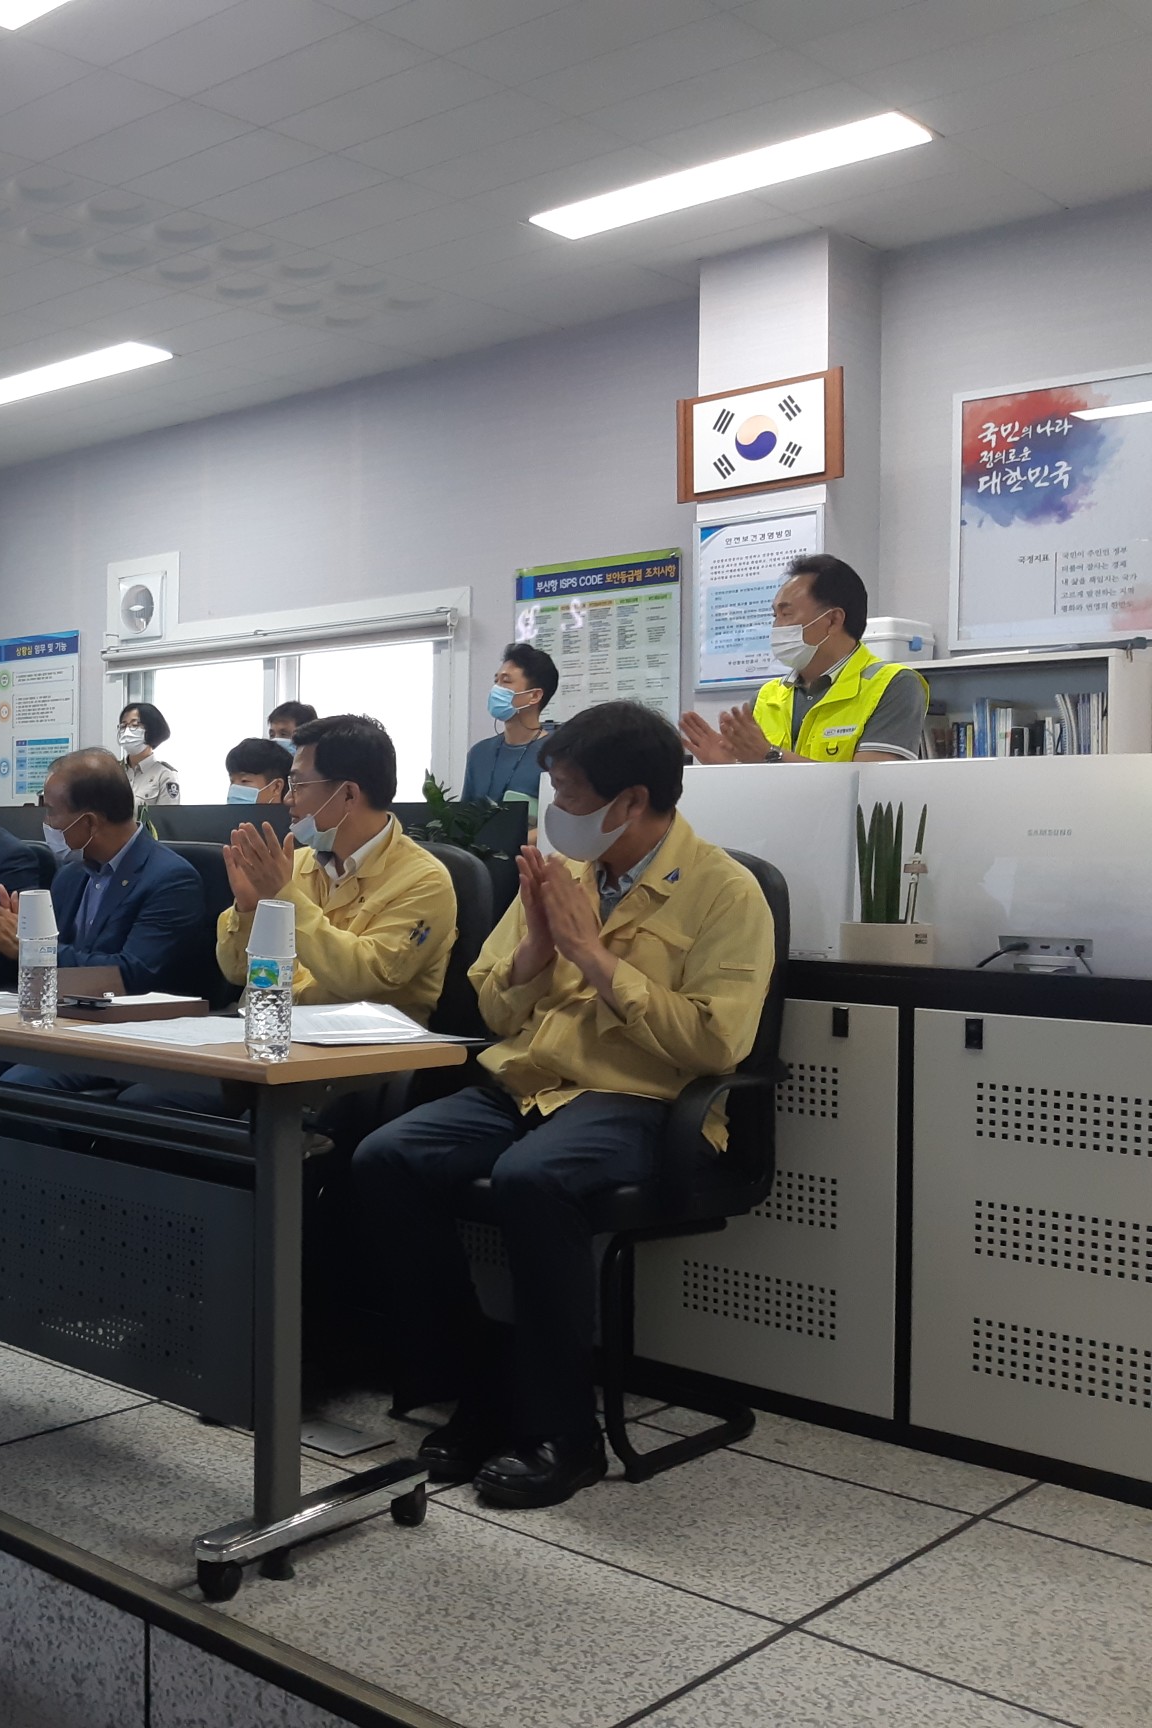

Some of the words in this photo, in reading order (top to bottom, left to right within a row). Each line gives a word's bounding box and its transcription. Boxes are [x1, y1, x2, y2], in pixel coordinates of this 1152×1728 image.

[978, 421, 1032, 448] 국민의
[1036, 418, 1073, 437] 나라
[979, 446, 1032, 468] 정의로운
[977, 461, 1072, 495] 대한민국
[536, 578, 558, 592] 부산항
[559, 576, 578, 589] ISPS
[578, 574, 603, 587] CODE
[605, 569, 642, 584] 보안등급별
[645, 564, 676, 578] 조치사항
[16, 645, 33, 657] 상황실
[55, 642, 67, 651] 기능
